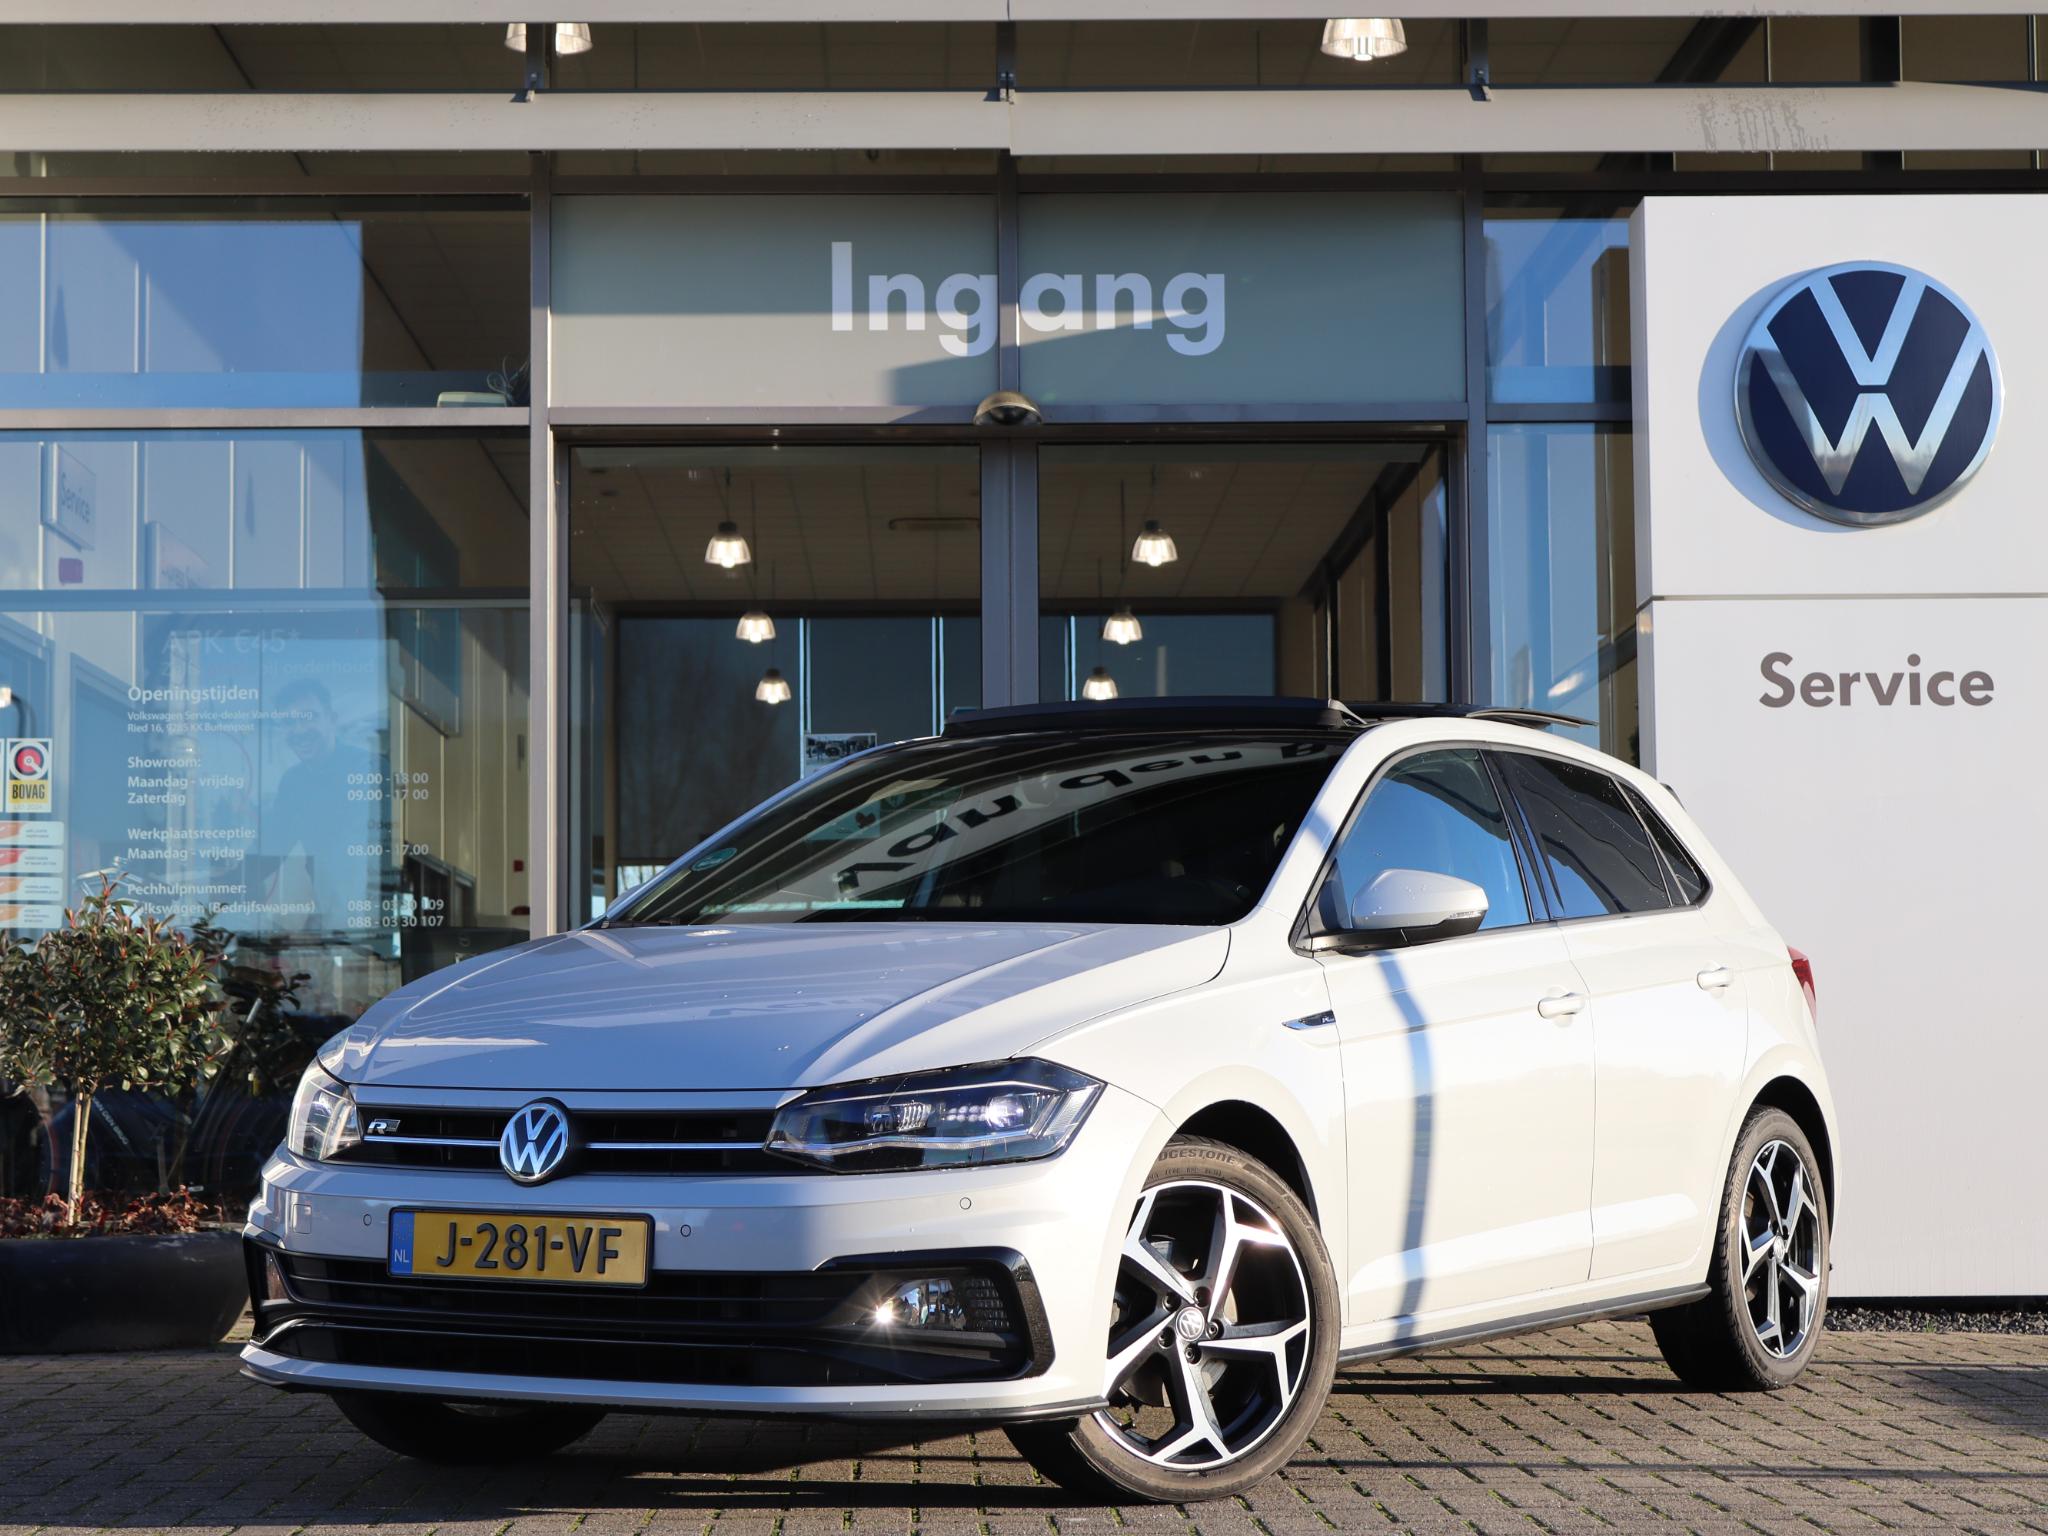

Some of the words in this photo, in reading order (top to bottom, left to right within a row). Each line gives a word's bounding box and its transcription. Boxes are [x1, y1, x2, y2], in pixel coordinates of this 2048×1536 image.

[832, 241, 1226, 357] Ingang
[1759, 651, 1995, 708] Service
[128, 685, 259, 705] Openingstijden
[128, 711, 183, 723] Volkswagen
[251, 710, 270, 720] Van
[270, 709, 289, 720] den
[290, 709, 313, 721] Brug
[128, 722, 148, 734] Ried
[151, 723, 165, 735] 16,
[128, 756, 202, 769] Showroom:
[128, 775, 188, 790] Maandag
[200, 775, 245, 789] vrijdag
[347, 773, 383, 785] 09.00
[394, 772, 429, 784] 1800
[12, 784, 46, 800] BOVAG
[128, 792, 187, 806] Zaterdag
[347, 789, 383, 801] 09.00
[394, 788, 429, 800] 1700
[128, 827, 256, 843] Werkplaatsreceptie:
[128, 847, 188, 861] Maandag
[200, 847, 245, 861] vrijdag
[347, 844, 383, 856] 08.00
[395, 844, 429, 856] 17.00
[128, 882, 247, 897] Pechhulpnummer:
[347, 901, 372, 911] 088
[347, 917, 372, 928] 088
[382, 916, 398, 927] 03
[401, 916, 417, 927] 30
[421, 916, 444, 927] 107
[1159, 1148, 1236, 1165] DGESTONE
[436, 1221, 623, 1275] J-281-VF
[393, 1249, 410, 1264] NL
